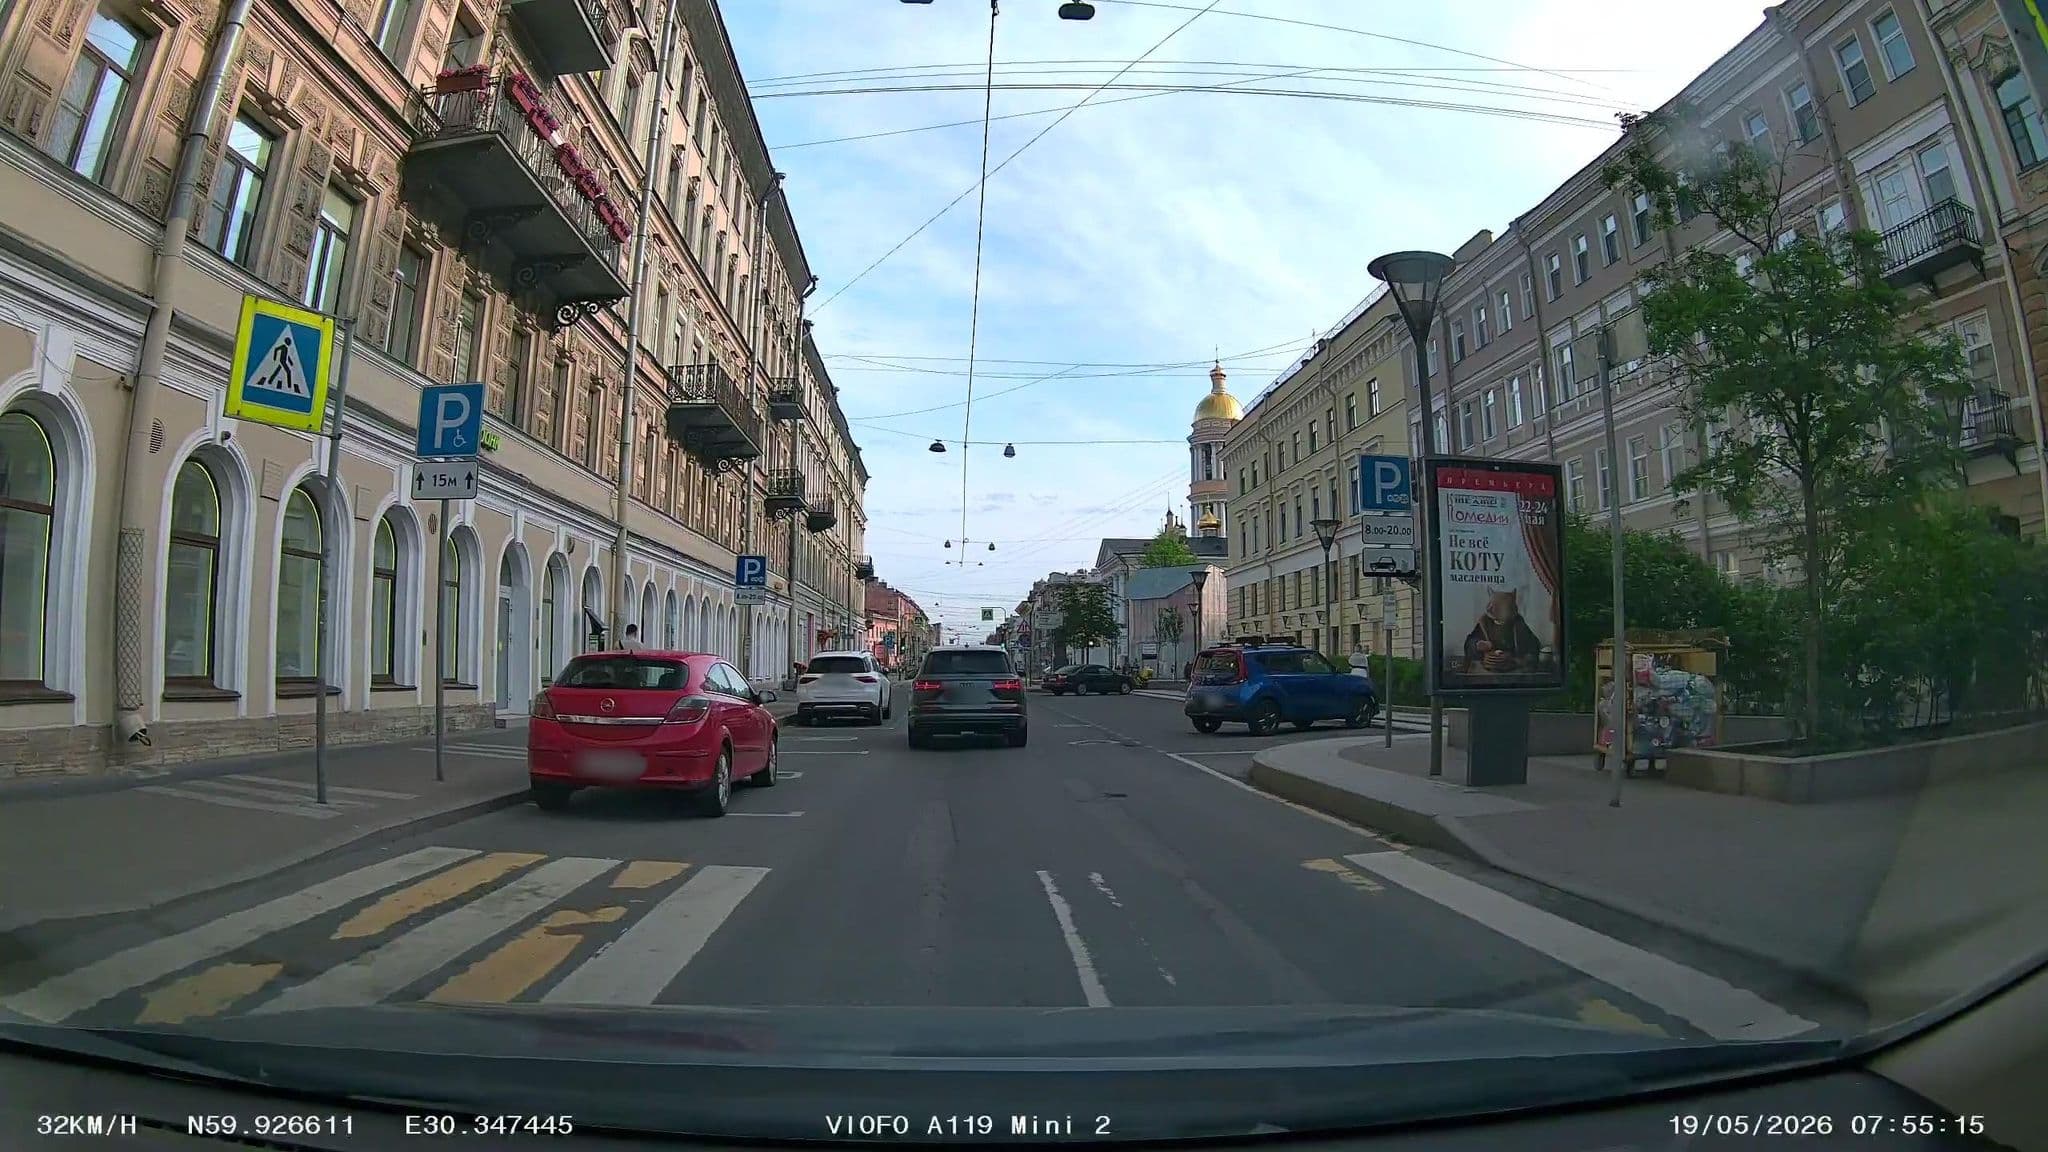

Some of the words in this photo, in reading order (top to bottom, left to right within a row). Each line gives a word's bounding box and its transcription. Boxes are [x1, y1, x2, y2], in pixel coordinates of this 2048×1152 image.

[434, 392, 470, 448] P
[1375, 461, 1402, 504] P
[1519, 499, 1547, 514] 22-24
[1365, 524, 1412, 535] 8.00-20.00
[1449, 534, 1467, 549] Не
[1468, 536, 1489, 549] всё
[1450, 550, 1505, 572] КОТУ
[744, 558, 761, 583] P
[1450, 573, 1505, 584] масленица
